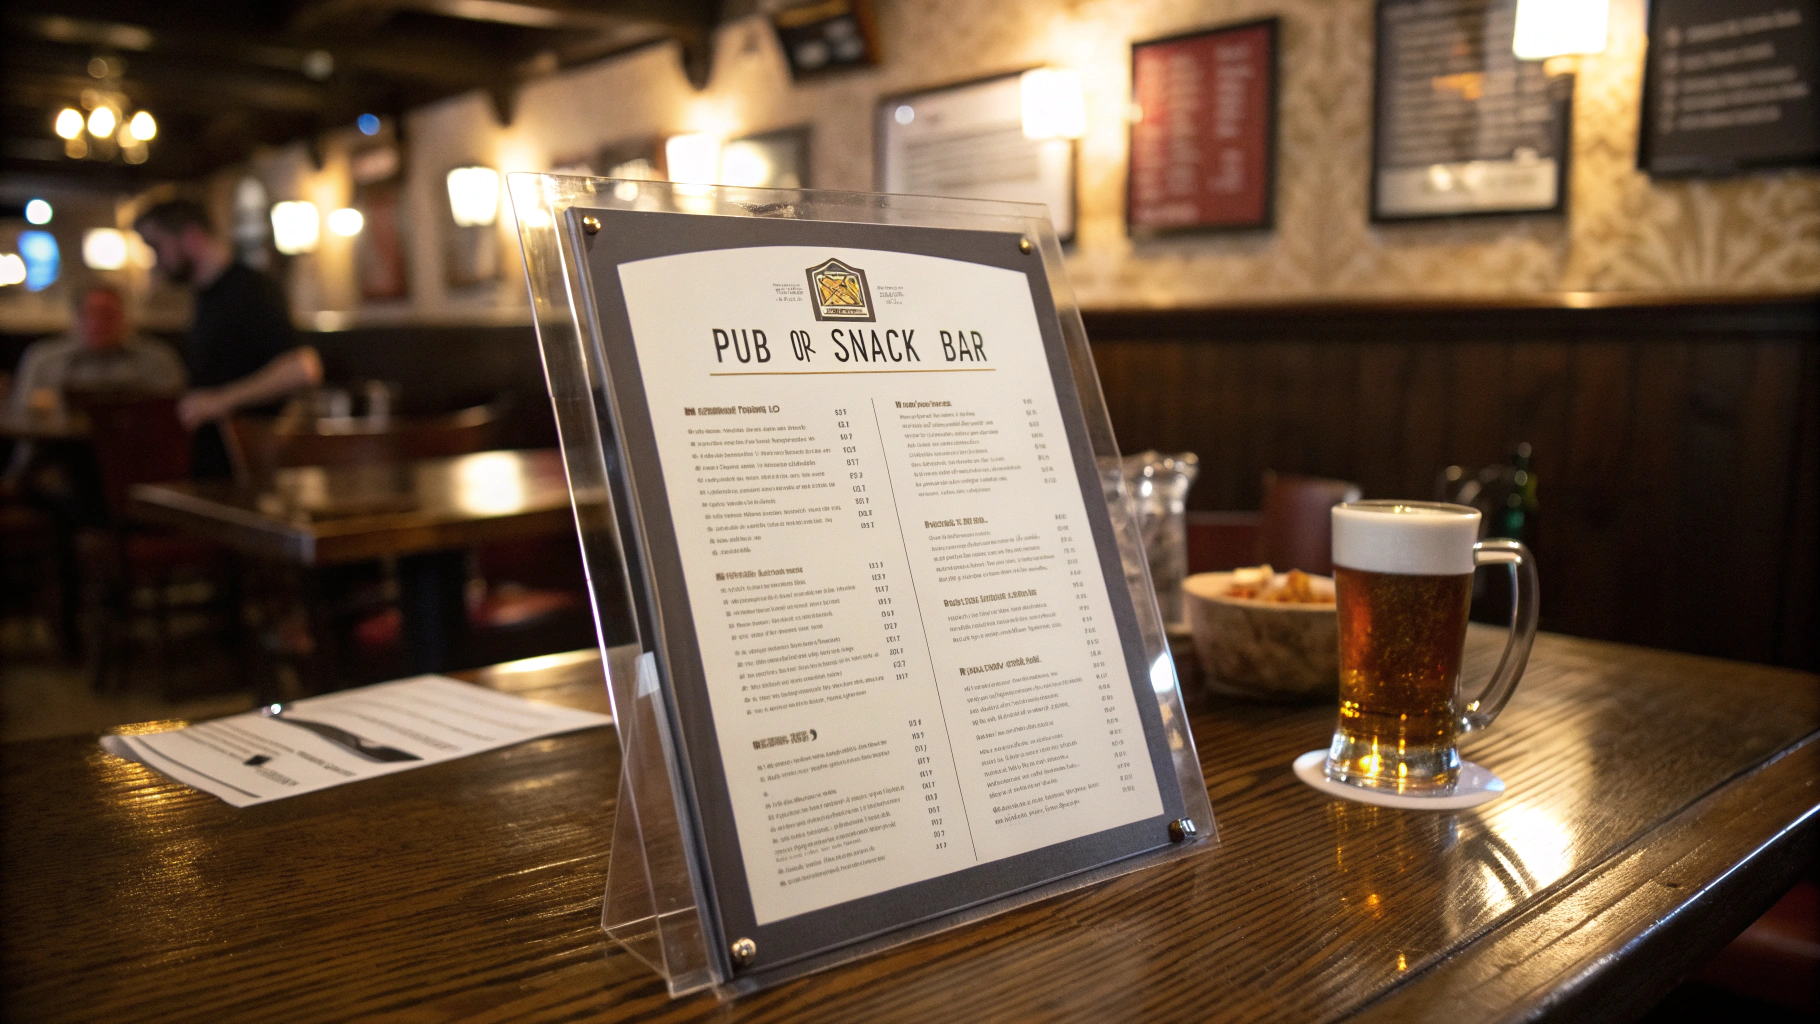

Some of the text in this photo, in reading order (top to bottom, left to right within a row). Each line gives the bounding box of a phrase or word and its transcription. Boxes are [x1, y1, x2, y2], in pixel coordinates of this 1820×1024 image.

[712, 328, 987, 363] PUB OR SNACK BAR
